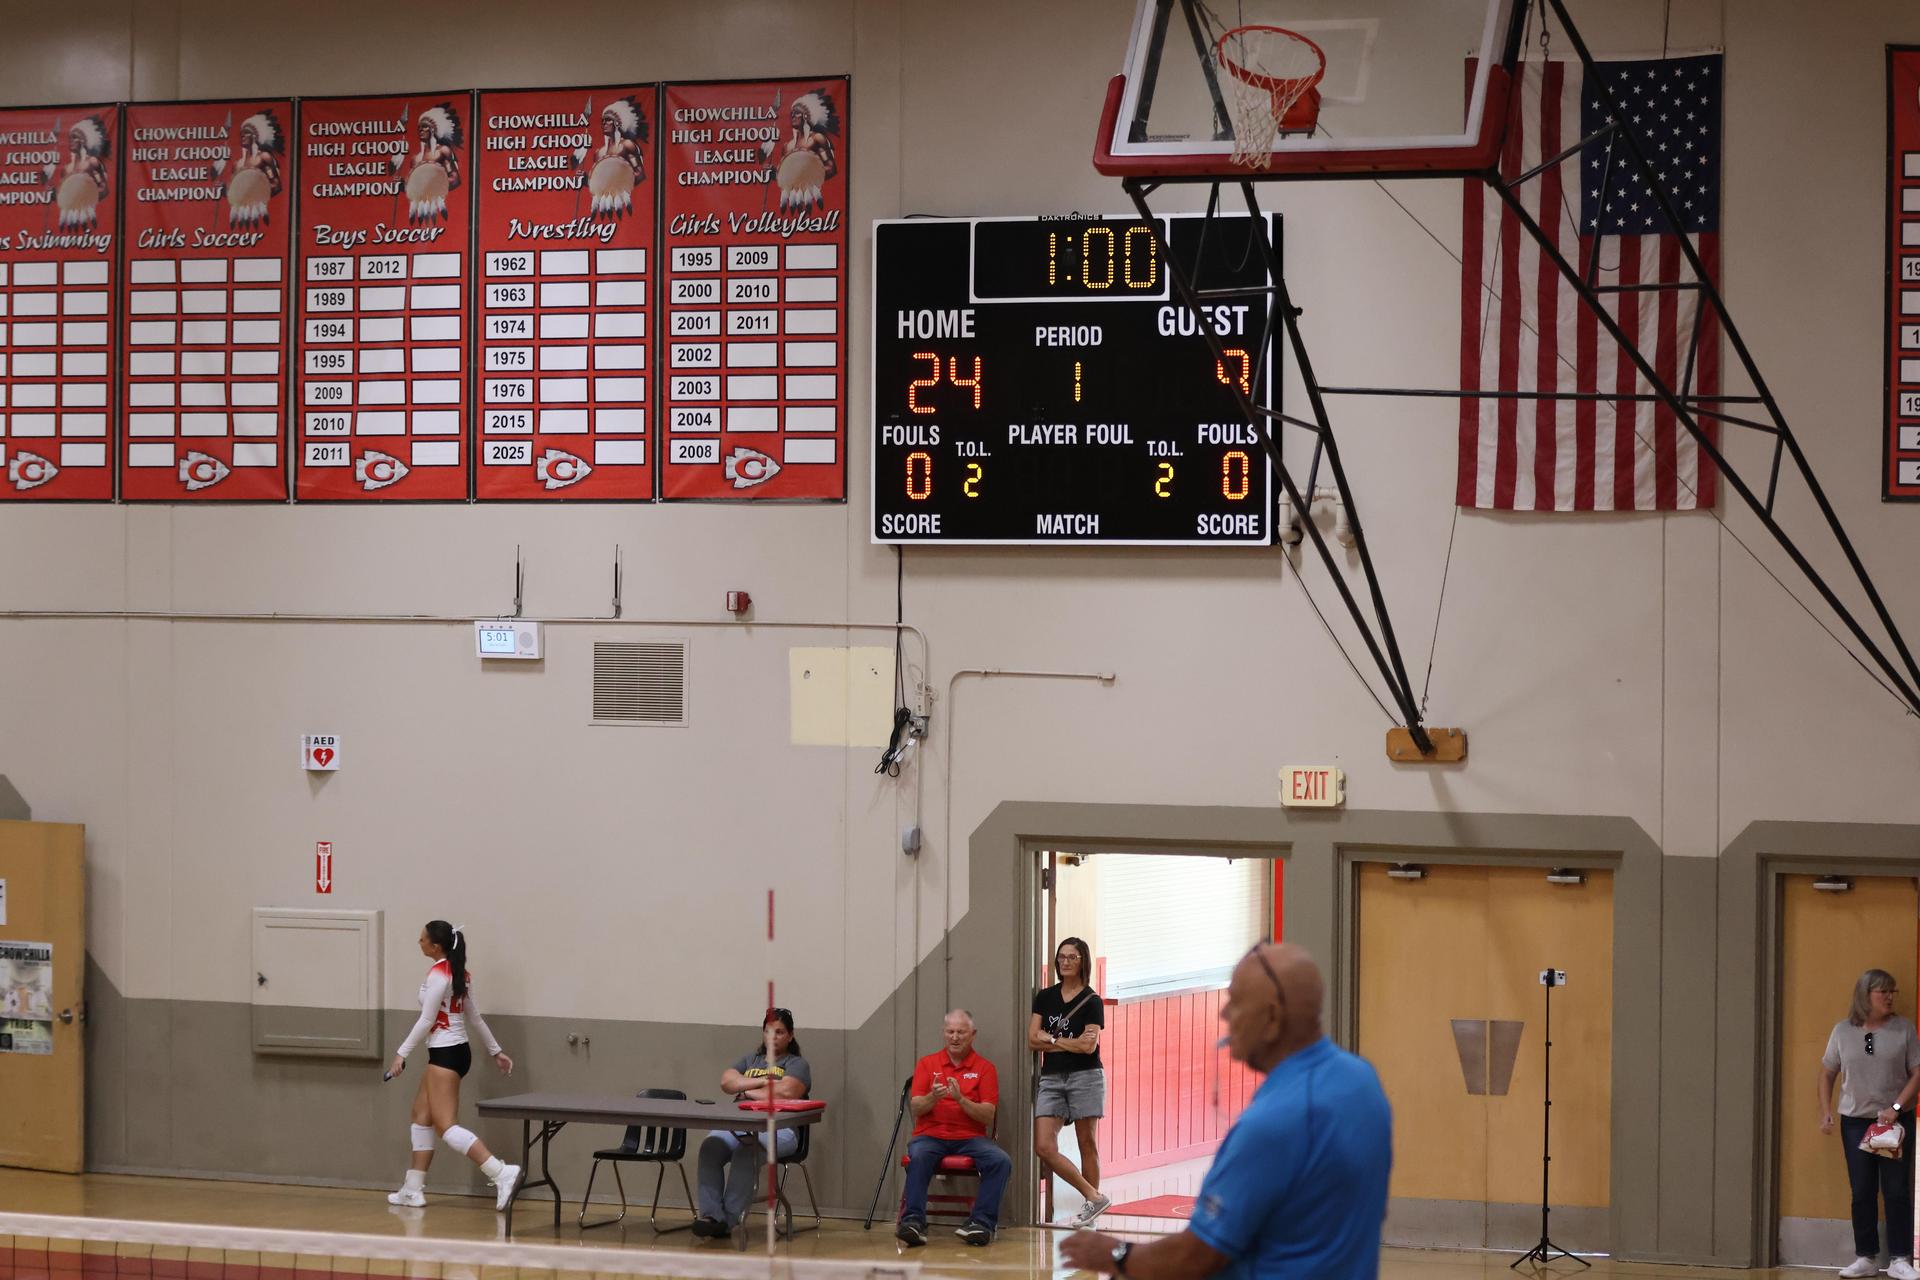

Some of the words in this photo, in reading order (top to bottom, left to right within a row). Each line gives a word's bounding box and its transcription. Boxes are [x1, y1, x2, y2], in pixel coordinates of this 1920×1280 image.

[488, 113, 589, 129] CHOWCHILLA
[674, 106, 777, 122] CHOWCHILLA
[134, 126, 228, 142] CHOWCHILLA
[309, 120, 406, 136] CHOWCHILLA
[671, 129, 712, 144] HIGH
[717, 127, 780, 142] SCHOOL
[307, 143, 345, 157] HIGH
[350, 141, 409, 155] SCHOOL
[486, 136, 526, 150] HIGH
[531, 134, 592, 149] SCHOOL
[5, 151, 60, 165] SCHOOL
[133, 147, 168, 161] HIGH
[174, 145, 230, 160] SCHOOL
[695, 149, 755, 164] LEAGUE
[329, 162, 386, 177] LEAGUE
[508, 155, 568, 171] LEAGUE
[152, 167, 208, 181] LEAGUE
[678, 169, 772, 186] CHAMPIONS
[312, 181, 401, 197] CHAMPIONS
[492, 175, 584, 191] CHAMPIONS
[137, 186, 223, 201] CHAMPIONS
[670, 211, 721, 236] Girls
[727, 209, 840, 239] Volleyball
[1041, 213, 1100, 222] DAKTRONICS
[313, 224, 367, 250] Boys
[372, 222, 445, 244] Soccer
[508, 216, 617, 243] Wrestling
[16, 229, 112, 252] Swimming
[137, 228, 186, 249] Girls
[190, 227, 264, 248] Soccer
[493, 257, 526, 271] 1962
[679, 252, 713, 266] 1995
[735, 251, 769, 265] 2009
[1049, 226, 1156, 289] 1:00
[313, 262, 346, 276] 1987
[367, 261, 400, 274] 2012
[492, 288, 526, 302] 1963
[678, 283, 713, 298] 2000
[735, 284, 770, 298] 2010
[313, 292, 346, 306] 1989
[492, 319, 526, 333] 1974
[677, 316, 712, 330] 2001
[736, 316, 769, 330] 2011
[897, 309, 976, 340] HOME
[1157, 305, 1249, 337] GUEST
[313, 323, 346, 337] 1994
[1035, 326, 1103, 347] PERIOD
[312, 354, 346, 368] 1995
[492, 351, 526, 365] 1975
[677, 348, 712, 362] 2002
[677, 381, 712, 395] 2003
[908, 352, 982, 414] 24
[1074, 360, 1082, 402] 1
[314, 387, 343, 400] 2009
[492, 384, 525, 398] 1976
[313, 417, 345, 431] 2010
[492, 415, 525, 429] 2015
[677, 412, 713, 426] 2004
[882, 425, 941, 447] FOULS
[1008, 424, 1078, 446] PLAYER
[1086, 424, 1134, 445] FOUL
[1198, 423, 1259, 445] FOULS
[312, 447, 343, 461] 2011
[492, 446, 525, 460] 2025
[679, 445, 712, 459] 2008
[955, 441, 992, 458] T.O.L.
[1147, 441, 1184, 457] T.O.L.
[905, 452, 932, 501] 0
[963, 462, 983, 498] 2
[1154, 462, 1175, 498] 2
[1222, 451, 1250, 501] 0
[882, 513, 941, 536] SCORE
[1036, 513, 1100, 535] MATCH
[1197, 513, 1259, 535] SCORE
[486, 632, 508, 642] 5:01
[313, 736, 335, 745] AED
[1293, 770, 1329, 800] EXIT
